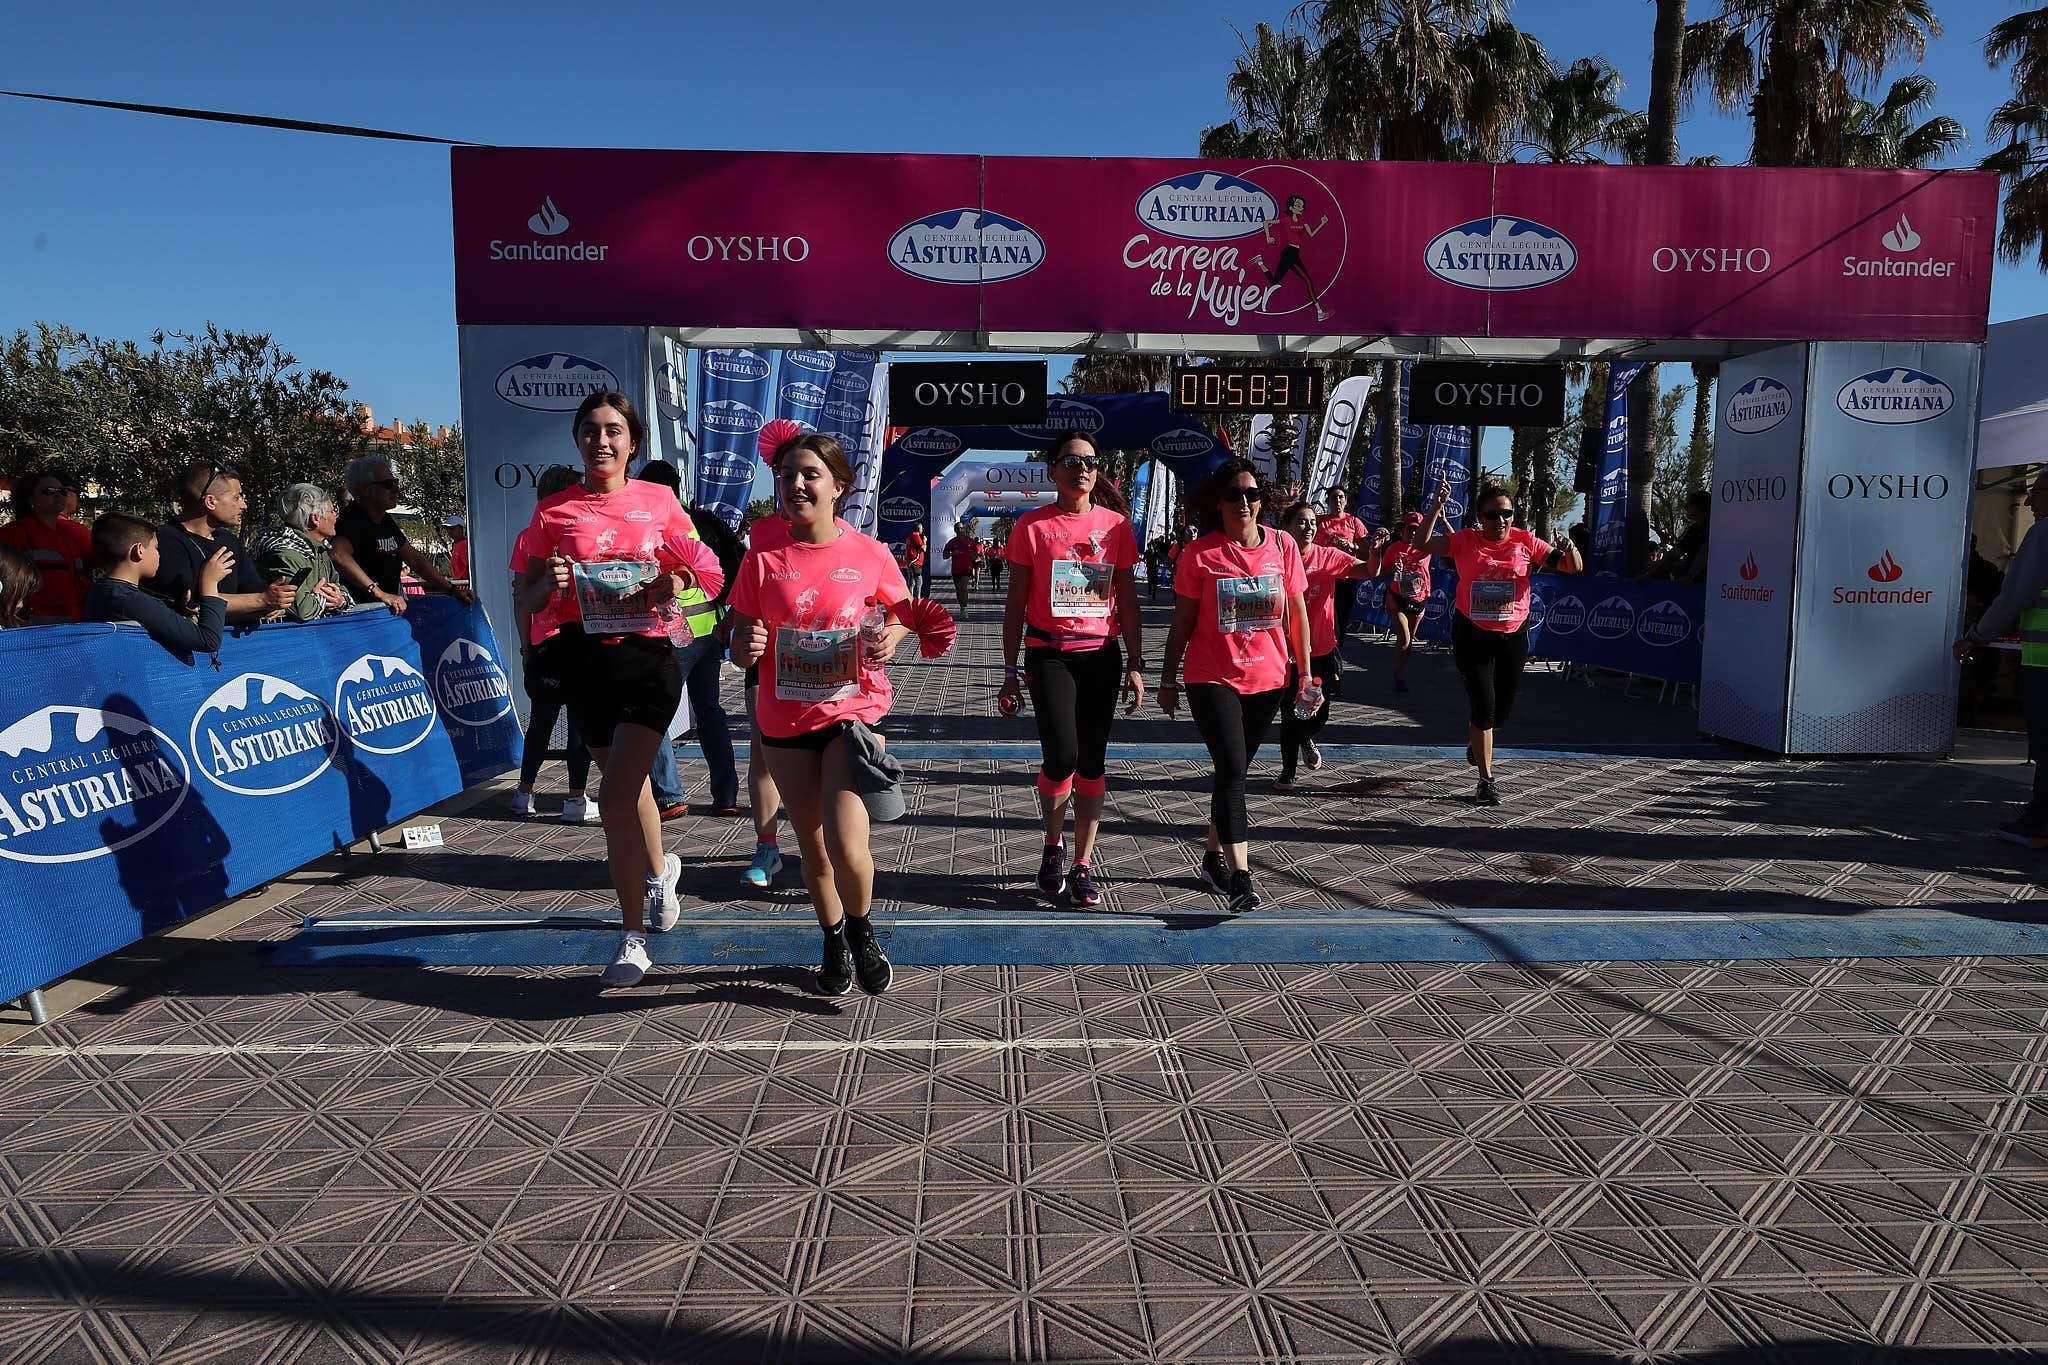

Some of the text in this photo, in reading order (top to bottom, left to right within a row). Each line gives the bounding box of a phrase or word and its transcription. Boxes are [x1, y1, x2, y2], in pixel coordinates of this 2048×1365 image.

[1147, 195, 1266, 223] ASTURIANA
[1169, 194, 1263, 204] CENTRAL LECHERA
[490, 239, 609, 262] Santander
[687, 235, 810, 263] OYSHO
[900, 235, 1033, 264] ASTURIANA
[924, 233, 1029, 242] CENTRAL ECHERA
[1512, 241, 1562, 250] LECHERA
[1123, 233, 1240, 271] Carrera
[1435, 242, 1566, 271] ASTURIANA
[1652, 246, 1771, 273] OYSHO
[1842, 255, 1957, 278] Santander
[1150, 268, 1282, 326] de la Mujer
[914, 382, 1026, 407] OYSHO
[1434, 382, 1543, 407] OYSHO
[1844, 389, 1945, 410] ASTURIANA
[1729, 400, 1787, 424] ASTURIANA
[1721, 475, 1787, 504] OYSHO
[1828, 474, 1949, 500] OYSHO
[1721, 584, 1774, 603] Santander
[1832, 586, 1933, 604] Santander
[356, 679, 422, 701] CENTRAL LECHERA
[222, 702, 320, 733] CENTRAL LECHERA
[346, 691, 433, 737] ASTURIANA
[207, 717, 334, 777] ASTURIANA
[12, 739, 160, 784] CENTRAL LECHERA
